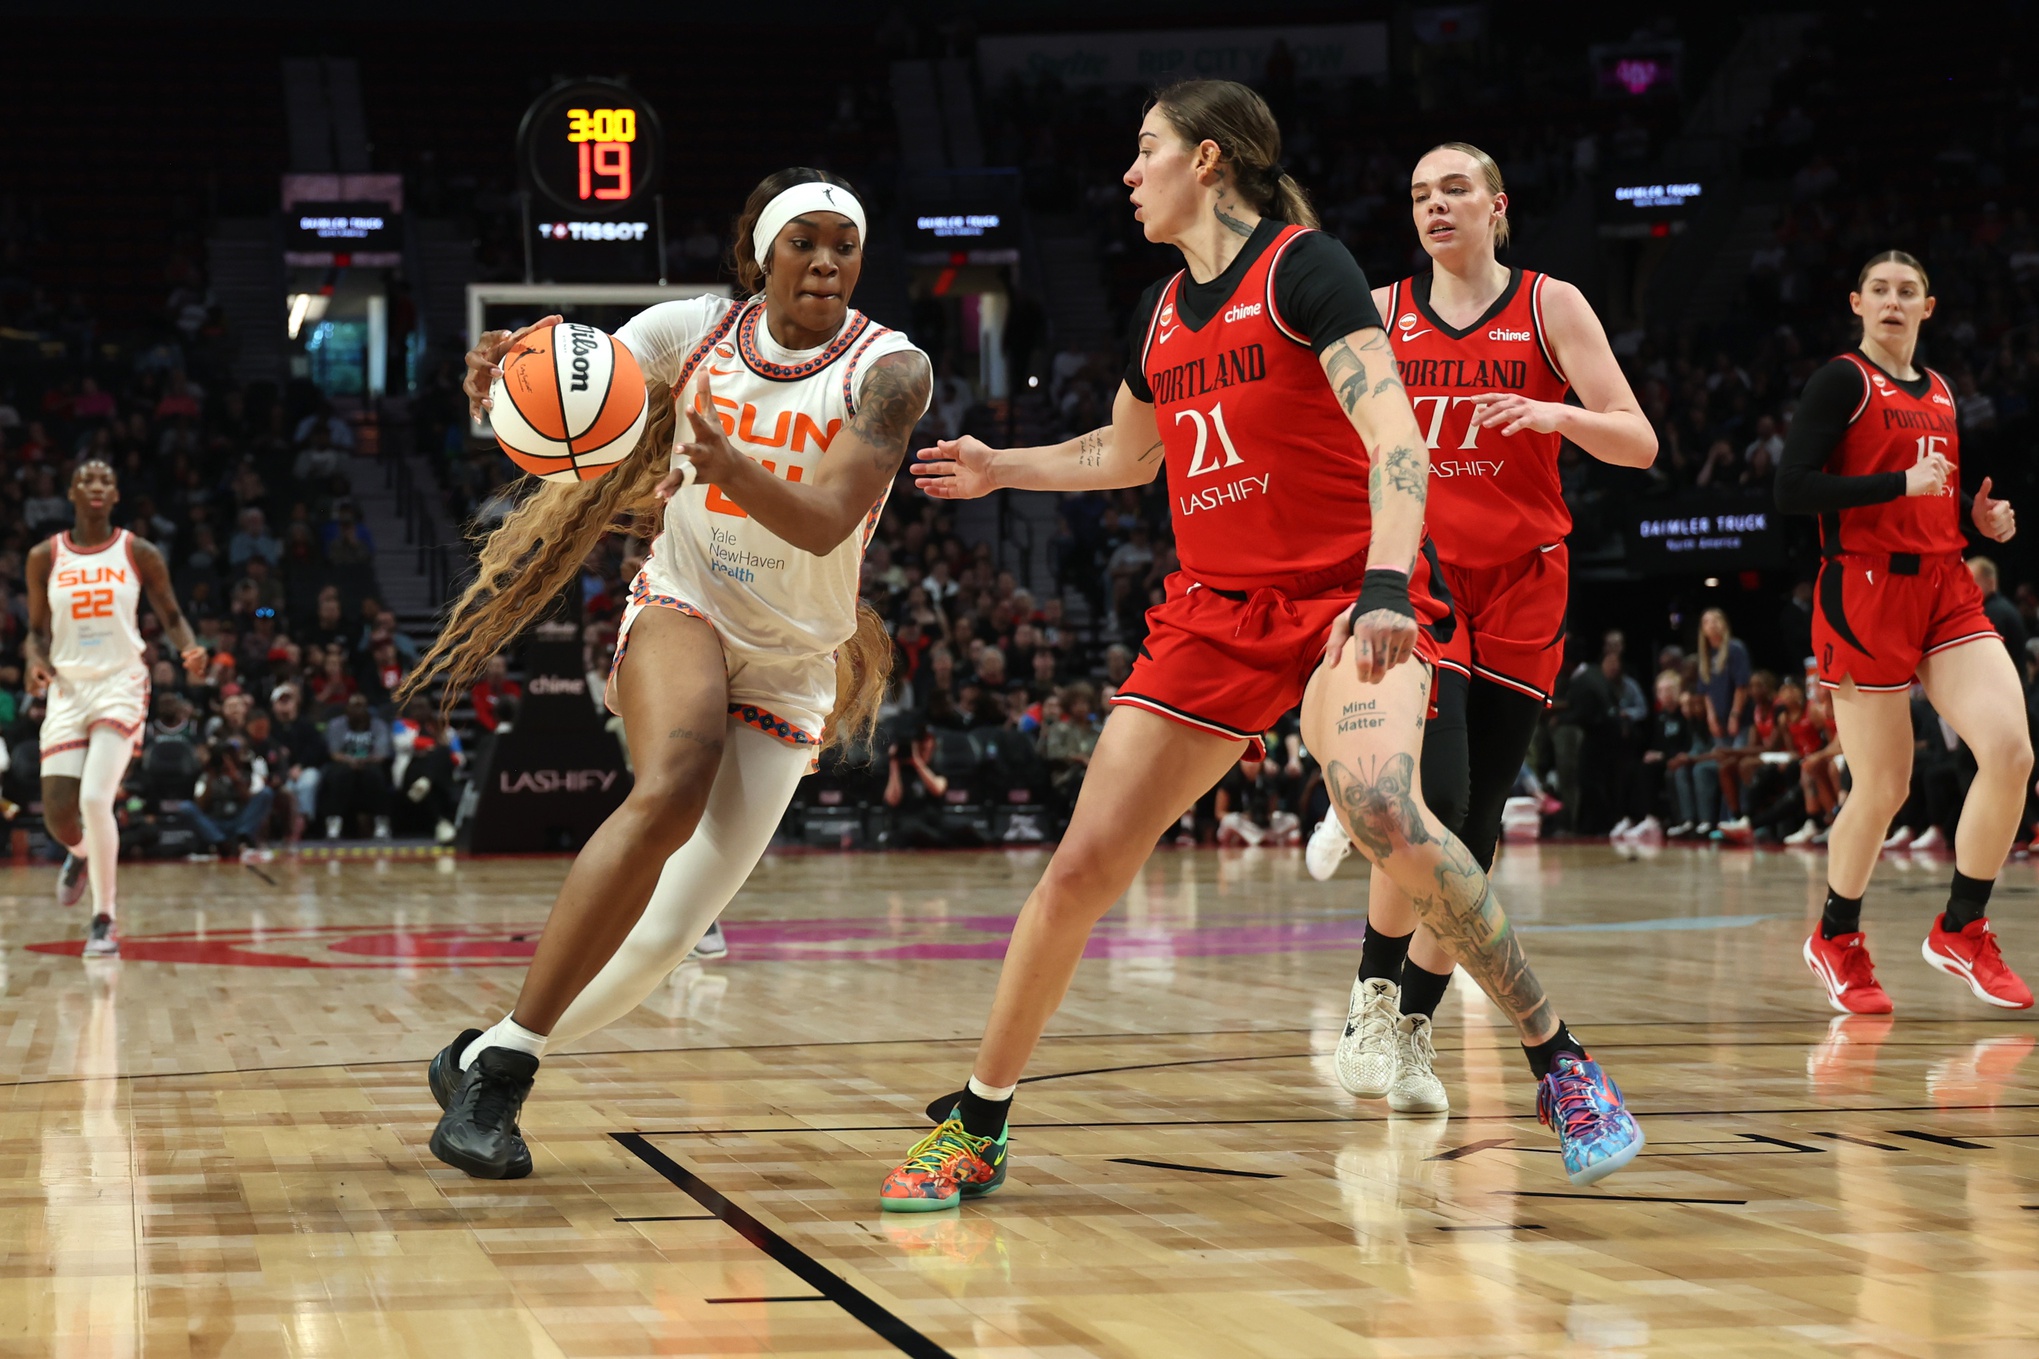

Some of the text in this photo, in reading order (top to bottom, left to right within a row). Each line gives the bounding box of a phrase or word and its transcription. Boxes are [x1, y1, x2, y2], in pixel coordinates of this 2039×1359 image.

[567, 109, 636, 142] 3:00
[578, 143, 632, 200] 19
[1224, 302, 1261, 323] chime
[1489, 328, 1530, 342] chime
[1152, 343, 1266, 409] PORTLAND
[694, 393, 842, 453] SUN
[1413, 395, 1488, 450] 77
[1175, 401, 1245, 478] 21
[1429, 459, 1504, 478] ASHIFY
[1180, 473, 1270, 516] LASHIFY
[711, 526, 736, 546] Yale
[1640, 513, 1767, 537] DAIMLER TRUCK
[709, 542, 785, 570] NewHaven
[57, 567, 126, 588] SUN
[711, 559, 754, 583] Health
[71, 589, 113, 620] 22
[529, 673, 586, 695] chime
[1342, 699, 1376, 716] Mind
[1337, 718, 1385, 735] Matter
[500, 769, 618, 794] LASHIFY
